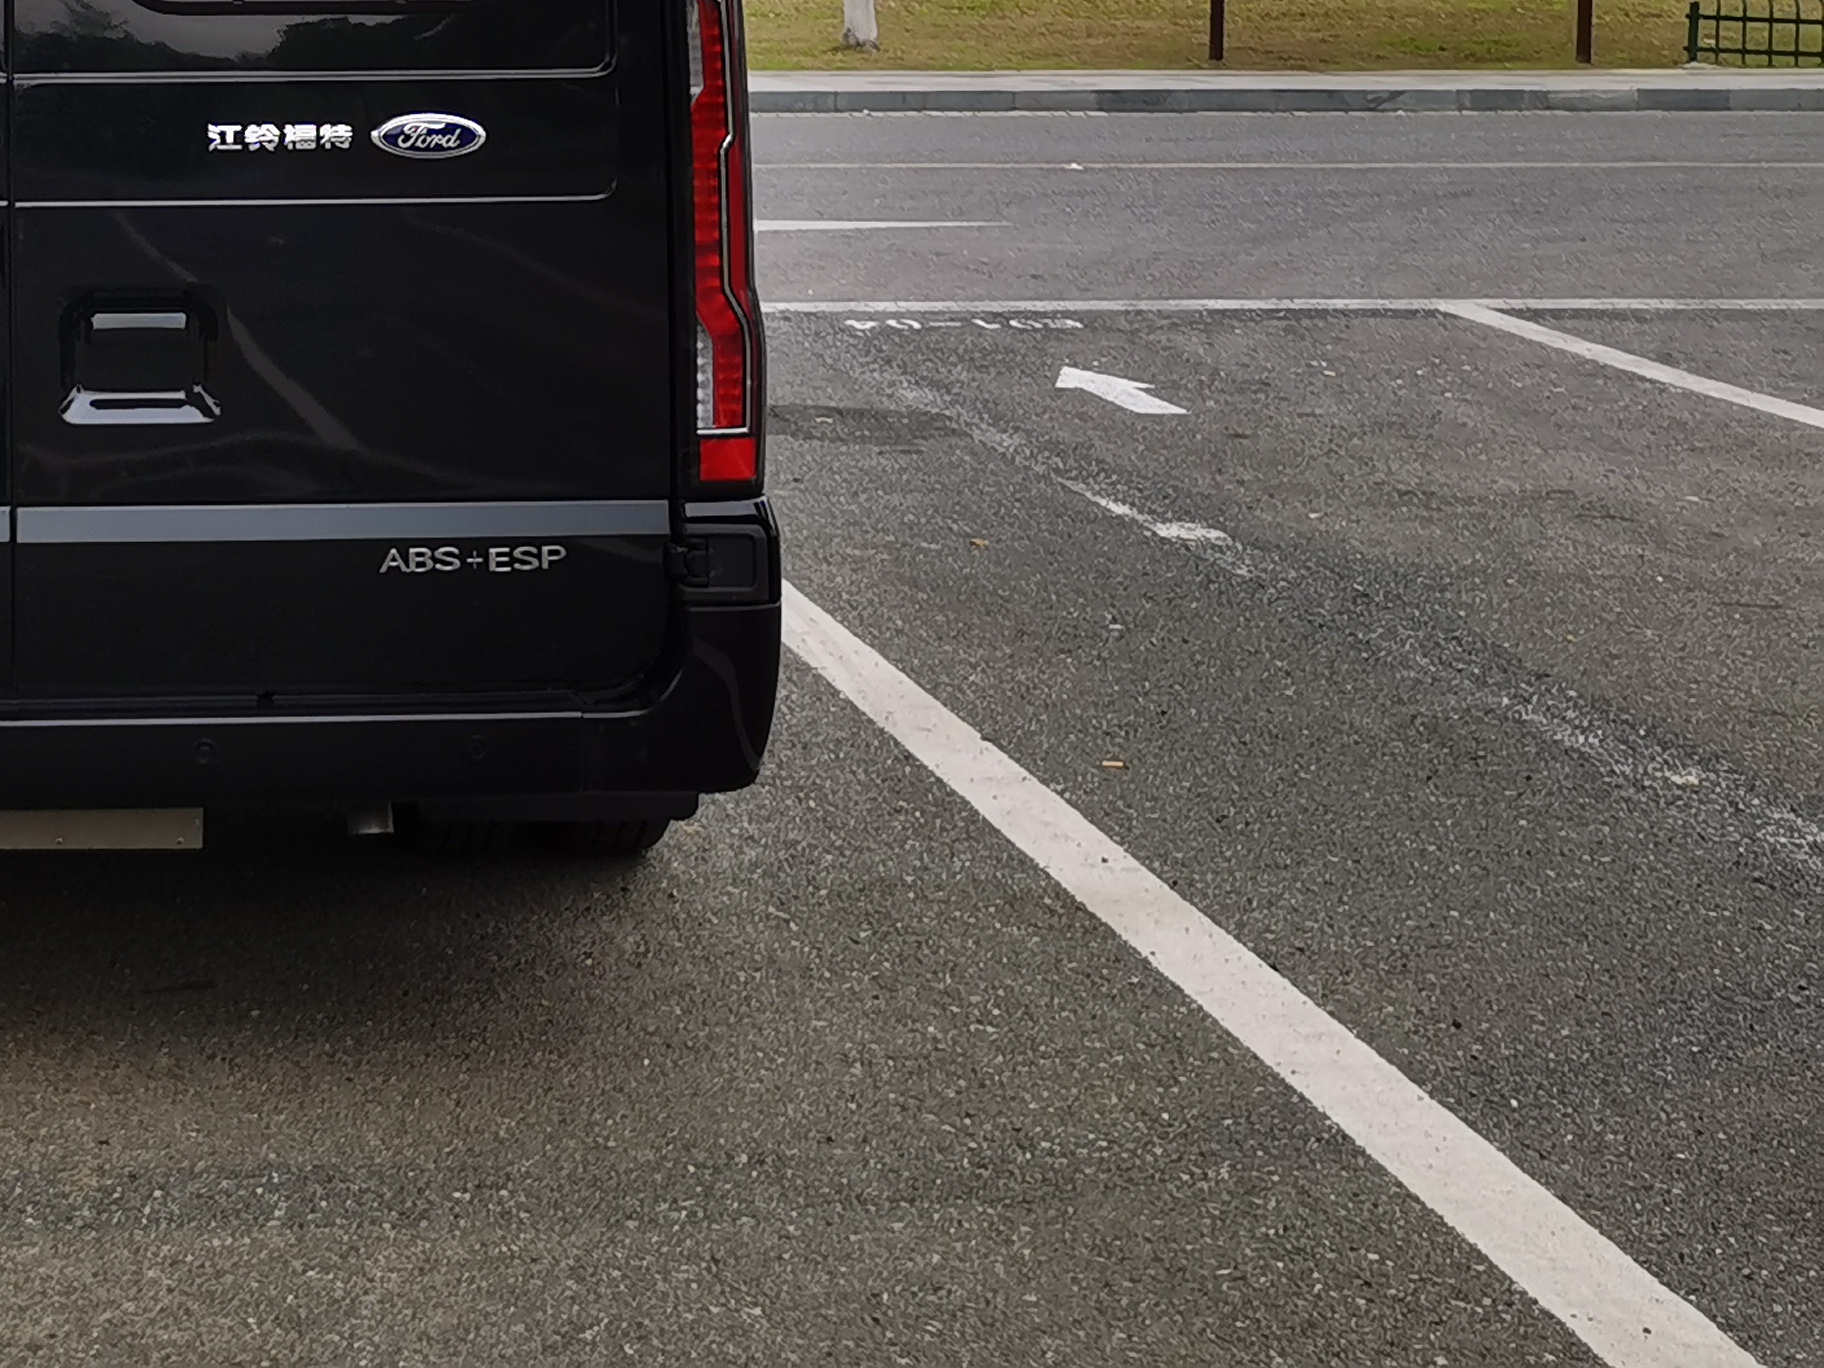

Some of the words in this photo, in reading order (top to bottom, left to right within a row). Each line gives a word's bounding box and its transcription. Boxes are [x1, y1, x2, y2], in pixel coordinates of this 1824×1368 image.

[207, 122, 354, 152] 江铃福特
[396, 121, 461, 150] Ford
[379, 545, 568, 574] ABS+ESP
